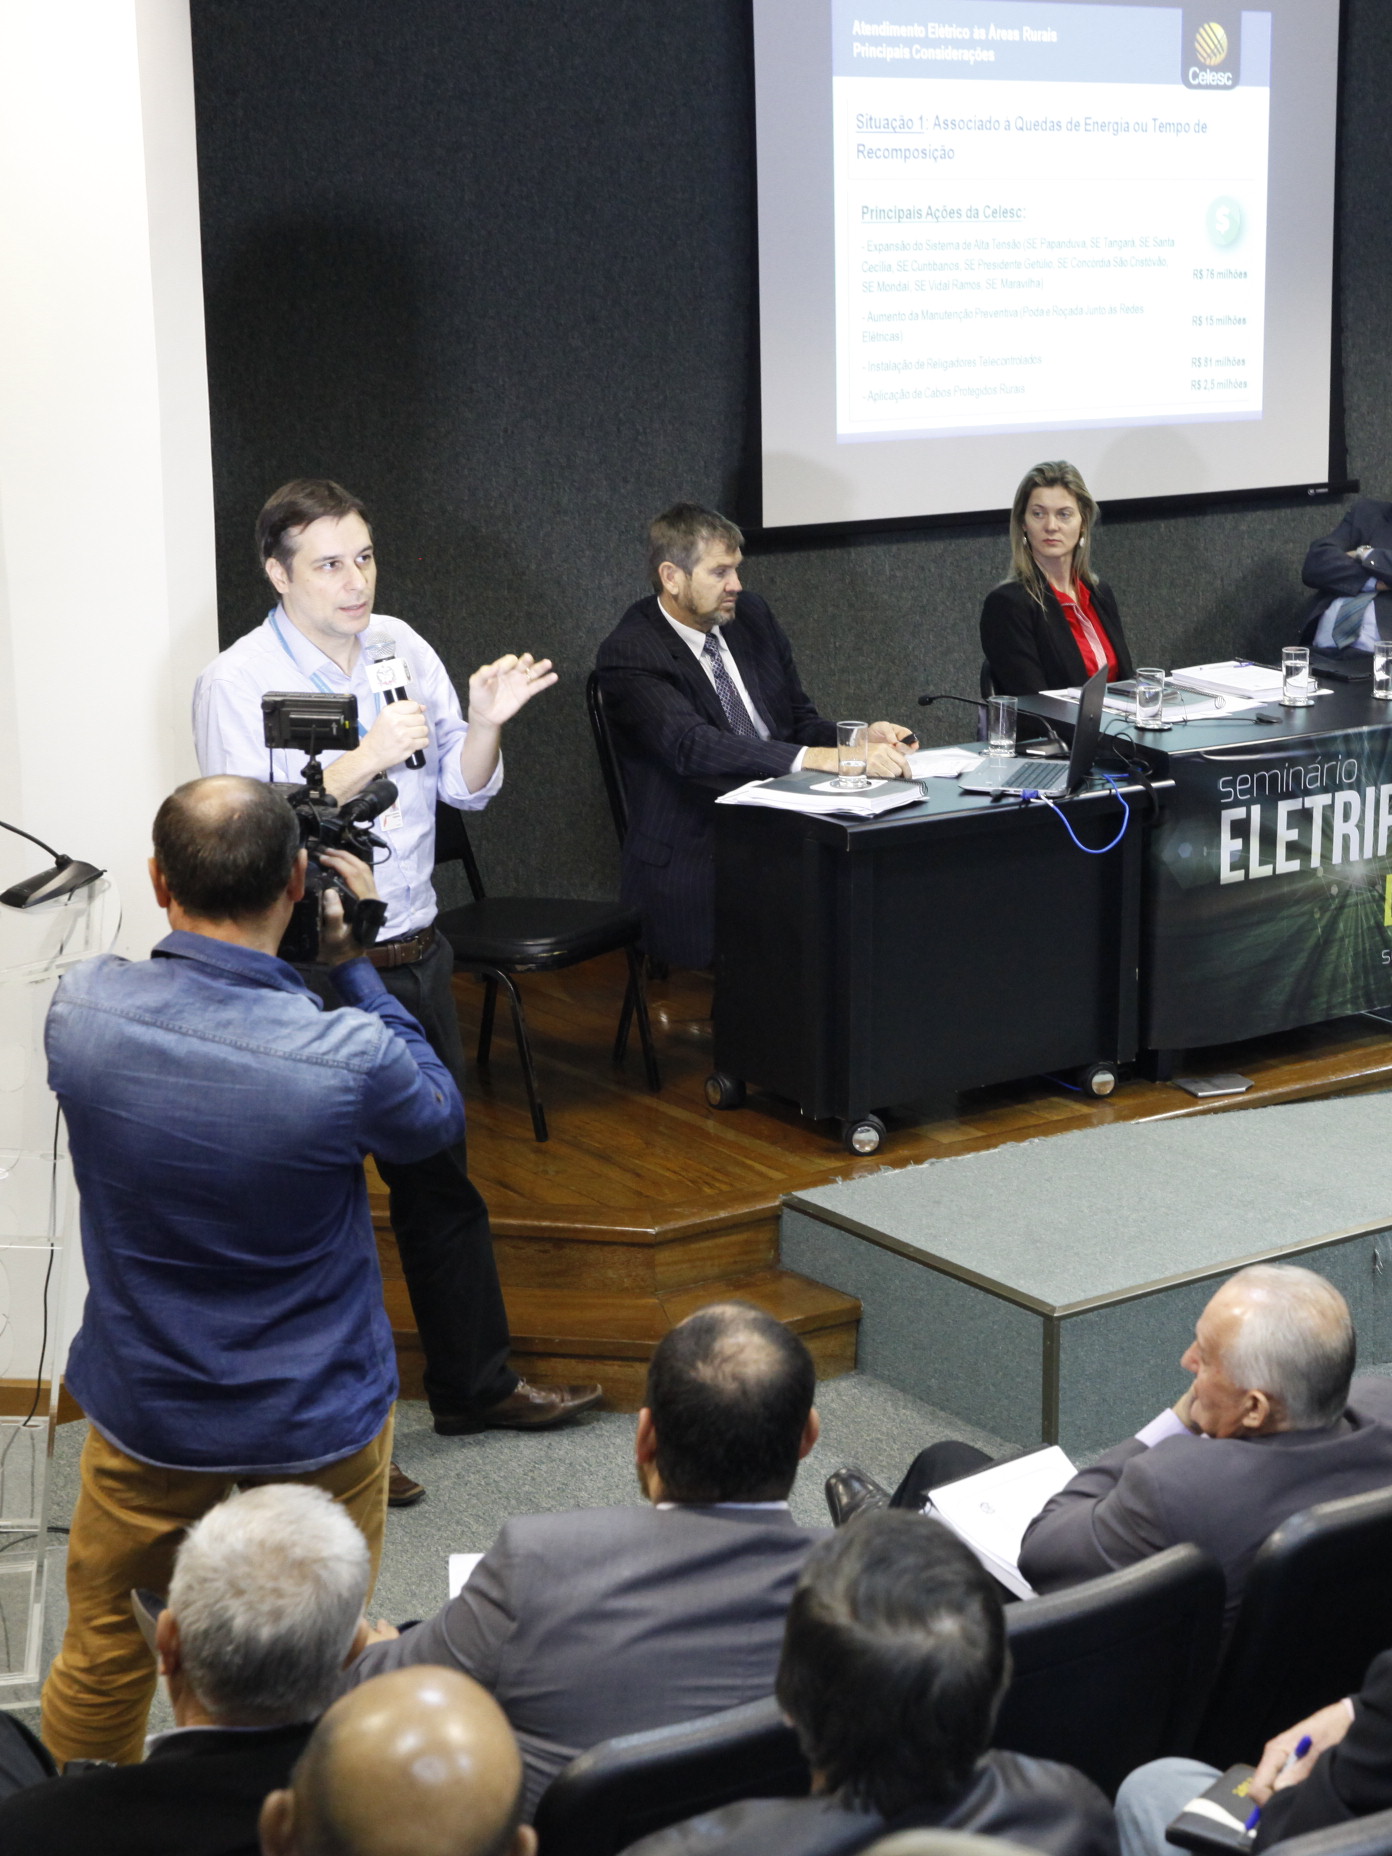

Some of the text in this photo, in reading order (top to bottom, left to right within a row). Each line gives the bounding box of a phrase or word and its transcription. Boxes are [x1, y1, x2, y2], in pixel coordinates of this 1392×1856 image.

[853, 20, 925, 38] Atendimento
[1022, 26, 1058, 42] Rurais
[853, 42, 995, 65] Principais Considerações
[1188, 66, 1233, 86] Celesc
[856, 113, 914, 133] Situação
[933, 114, 1001, 131] Associado
[1014, 115, 1063, 132] Quedas
[1065, 116, 1081, 132] de
[1084, 116, 1130, 136] Energia
[1133, 121, 1148, 132] ou
[1151, 118, 1191, 137] Tempo
[1193, 119, 1208, 134] de
[856, 143, 955, 163] Recomposição
[861, 205, 923, 222] Principais
[925, 205, 963, 222] Ações
[965, 205, 980, 219] da
[1216, 268, 1248, 280] milhões
[1216, 314, 1247, 326] milhões
[1214, 356, 1246, 368] milhões
[1216, 378, 1248, 390] milhões
[1219, 754, 1358, 803] seminário
